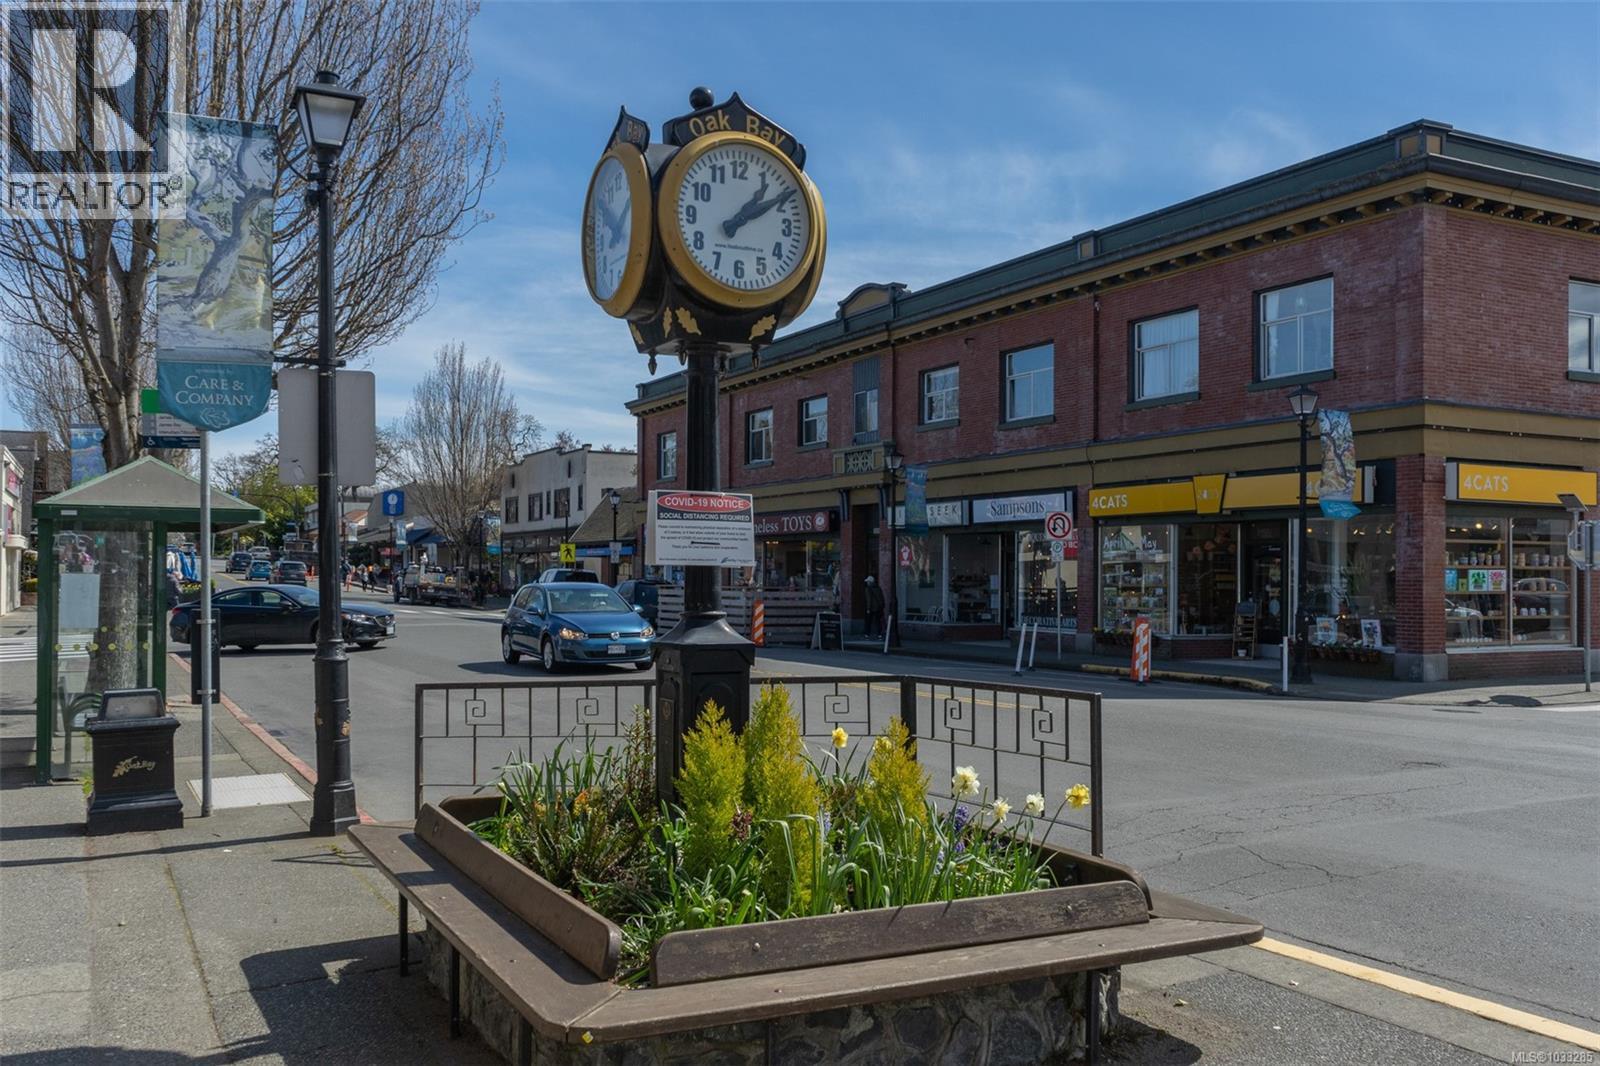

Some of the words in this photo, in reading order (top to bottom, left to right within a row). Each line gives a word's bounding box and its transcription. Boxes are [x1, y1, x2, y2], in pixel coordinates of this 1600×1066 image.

[689, 109, 732, 137] Oak
[745, 114, 787, 146] Bay
[709, 164, 726, 185] 11
[729, 160, 748, 181] 12
[691, 181, 712, 202] 10
[685, 204, 697, 225] 9
[781, 218, 792, 237] 3
[693, 231, 704, 250] 8
[712, 251, 722, 270] 7
[772, 241, 784, 261] 4
[733, 260, 745, 279] 6
[755, 256, 768, 276] 5
[184, 375, 229, 390] CARE
[232, 380, 245, 391] &
[175, 390, 254, 406] COMPANY
[1464, 474, 1509, 492] 4CATS
[664, 496, 708, 507] COVID-19
[710, 499, 745, 509] NOTICE
[929, 503, 958, 517] SEEK
[1092, 494, 1128, 510] 4CATS
[659, 512, 682, 520] SOCIAL
[683, 513, 719, 521] DISTANCING
[782, 515, 812, 532] TOYS
